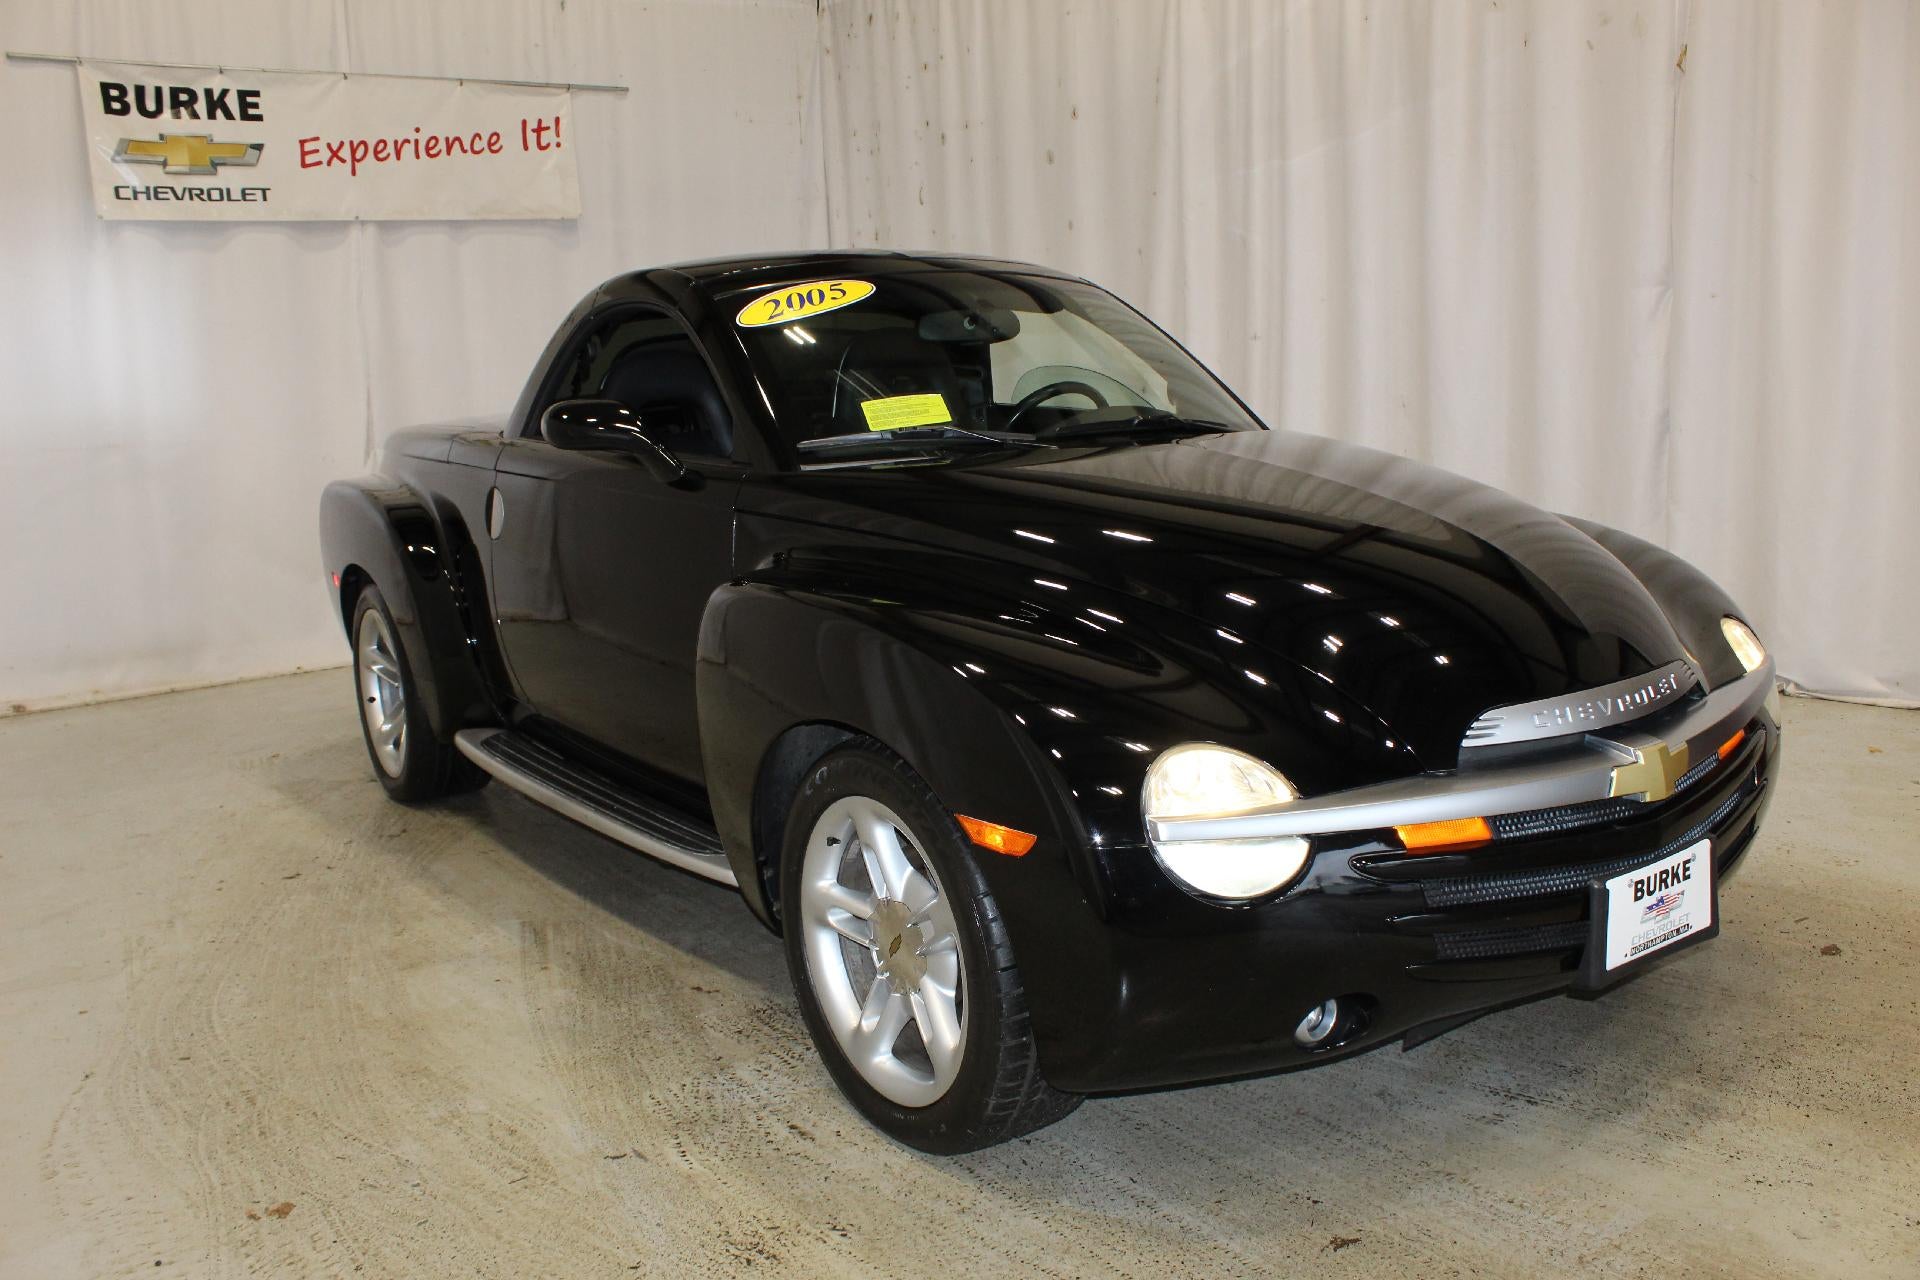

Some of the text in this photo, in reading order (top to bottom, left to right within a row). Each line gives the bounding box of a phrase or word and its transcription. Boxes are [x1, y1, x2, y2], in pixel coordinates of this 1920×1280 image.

[99, 81, 264, 122] BURKE
[298, 116, 564, 176] Experience It!
[113, 184, 271, 202] CHEVROLET
[763, 283, 847, 321] 2005
[1532, 673, 1677, 728] CHEVROLET
[1633, 858, 1692, 902] BURKE
[1631, 912, 1691, 946] CHEVROLET
